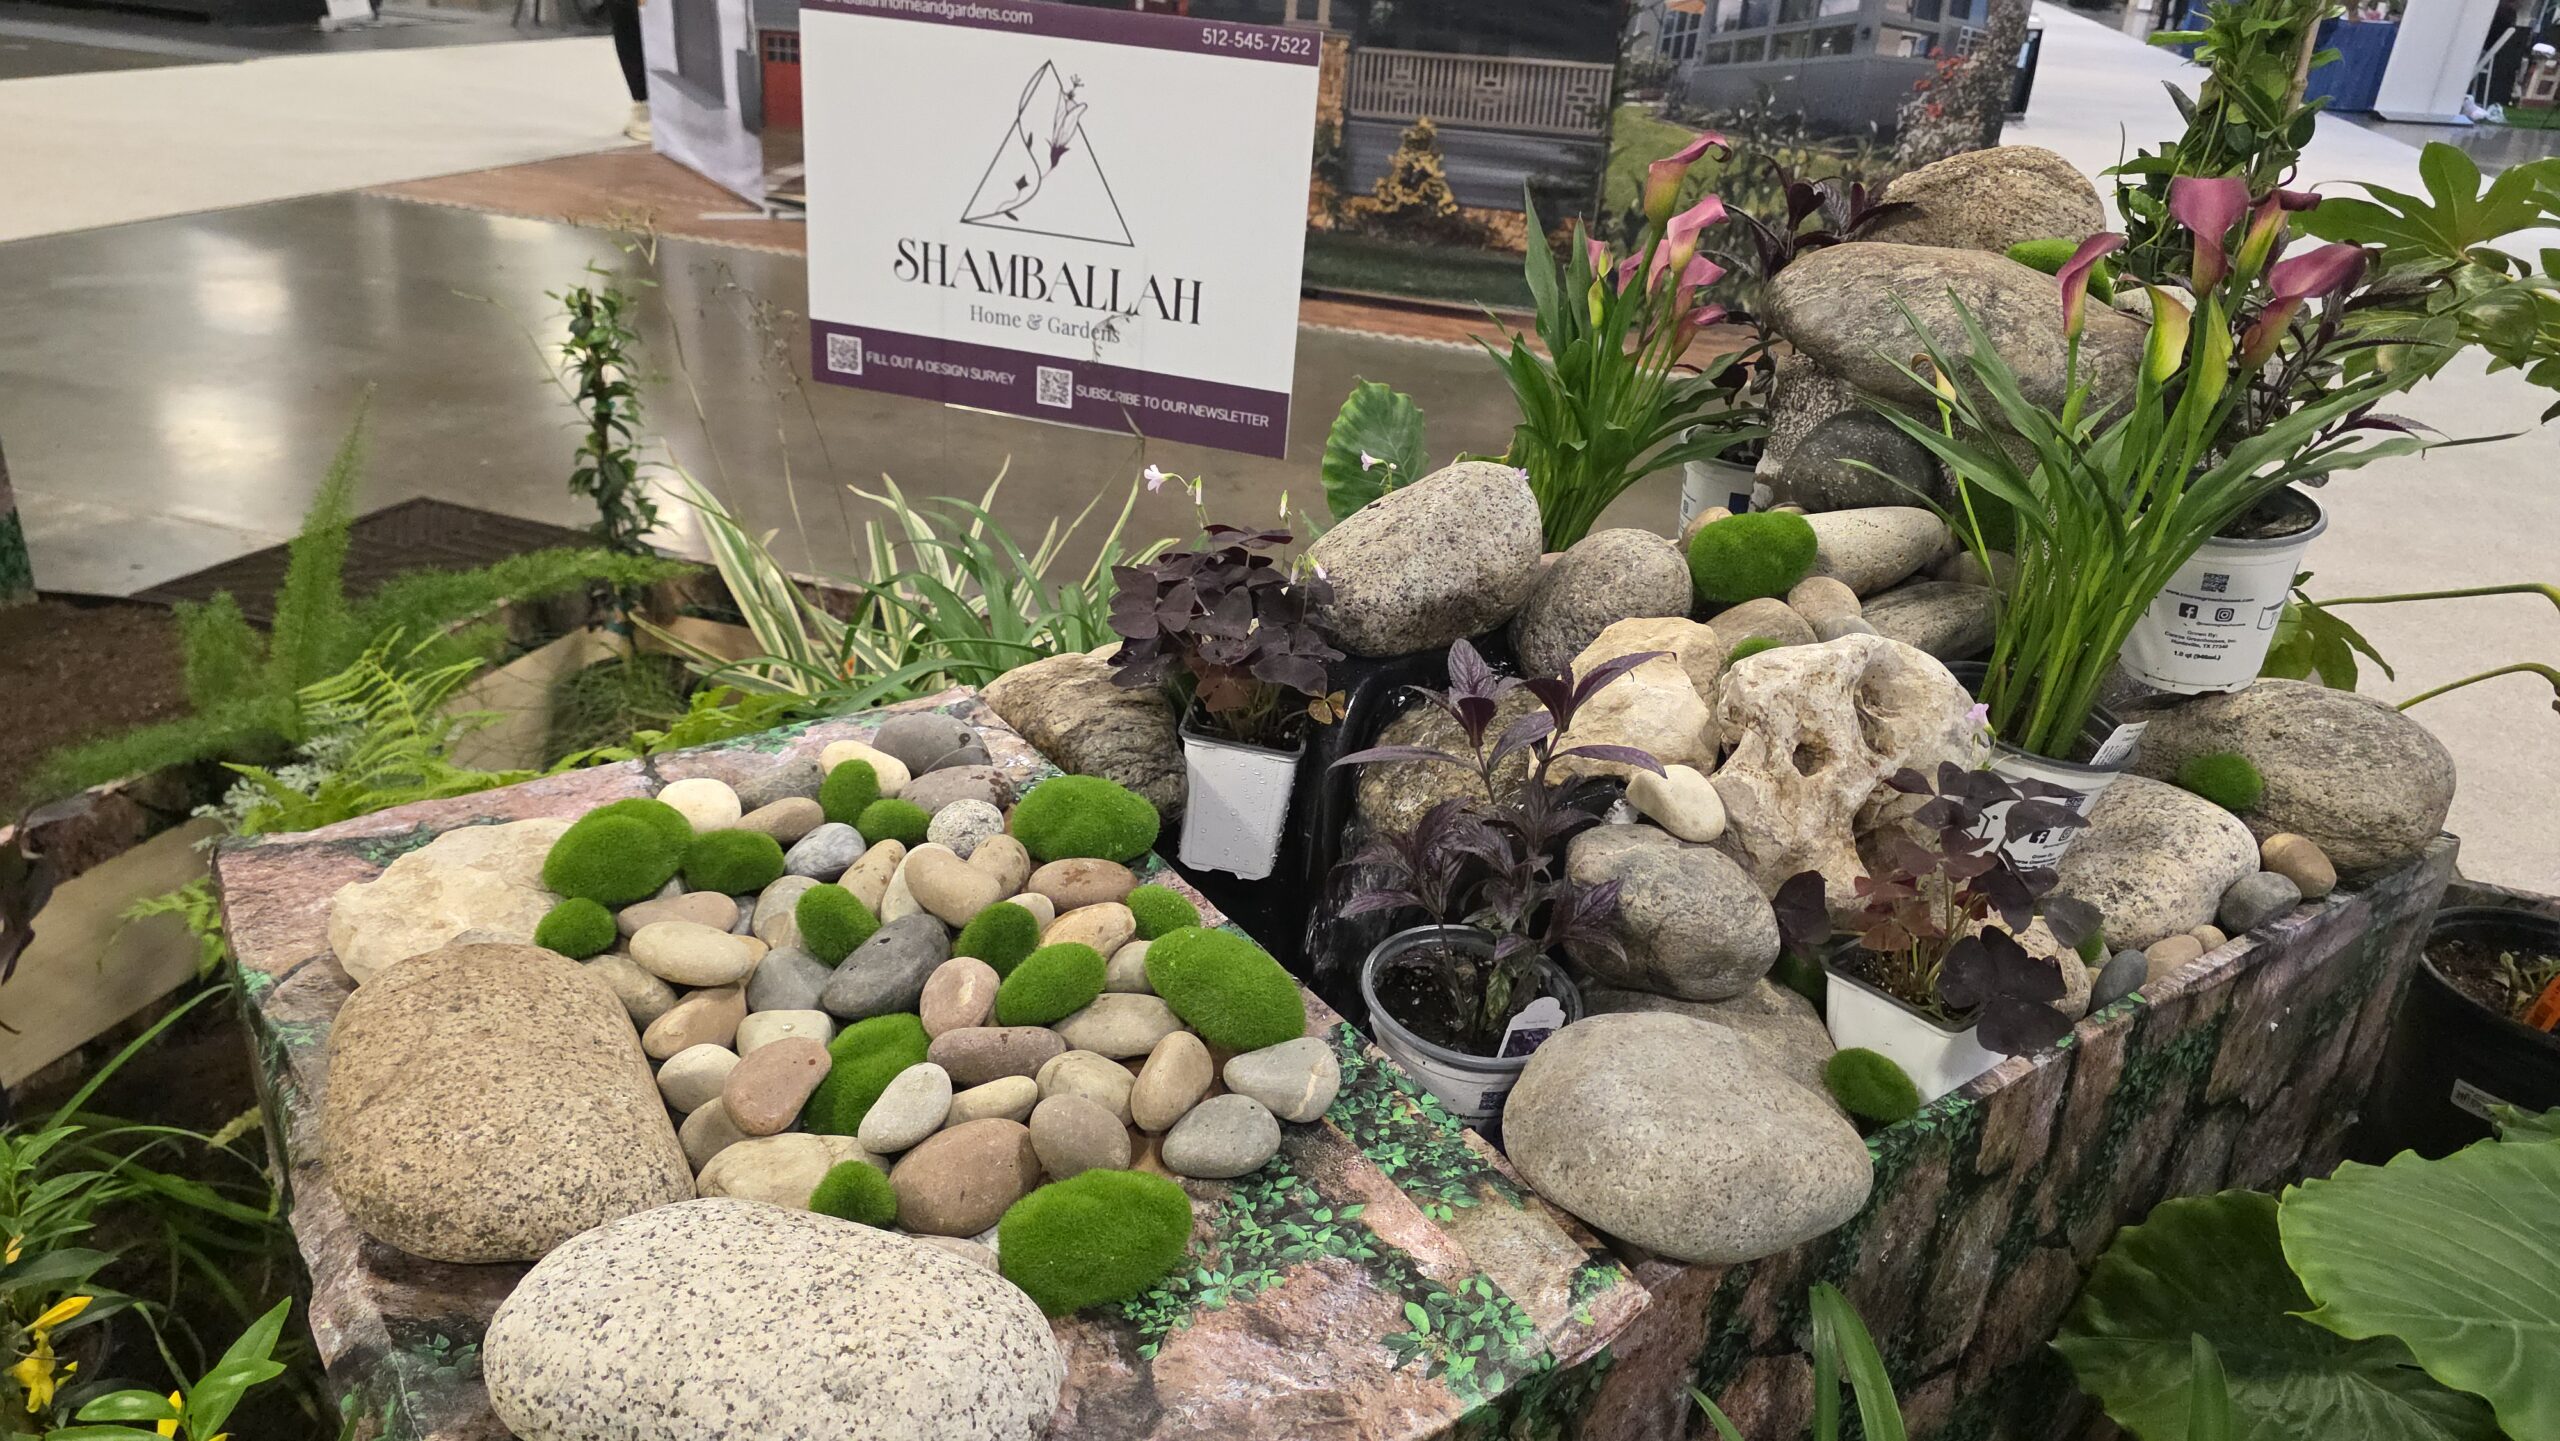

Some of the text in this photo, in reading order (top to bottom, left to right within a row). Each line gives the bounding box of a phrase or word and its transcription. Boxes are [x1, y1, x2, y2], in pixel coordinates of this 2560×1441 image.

[823, 0, 1033, 25] aahhomeandgardens.com
[1201, 27, 1311, 56] 512-545-7522
[893, 237, 1203, 325] SHAMBALLAH
[970, 304, 1121, 344] Home & Gardens
[866, 351, 1016, 385] FILL OUT A DESIGN SURVEY
[1075, 384, 1269, 428] SUBSCRIBE TO OUR NEWSLETTER
